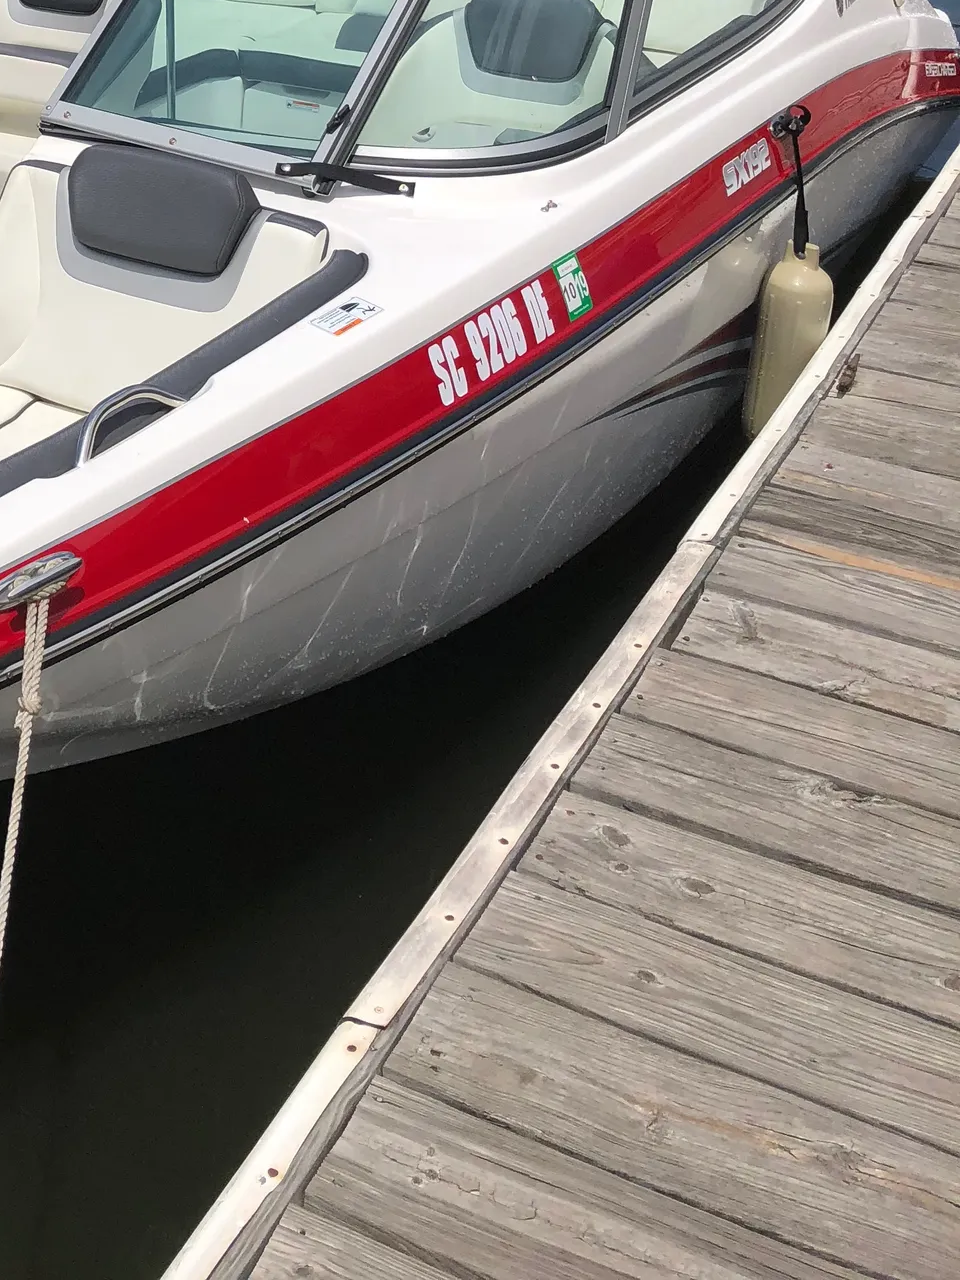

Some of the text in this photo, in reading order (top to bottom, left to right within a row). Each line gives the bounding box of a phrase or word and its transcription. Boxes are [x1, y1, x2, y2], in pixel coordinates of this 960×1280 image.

[722, 137, 771, 197] SX192
[563, 282, 577, 302] 10
[573, 270, 590, 299] 19
[427, 279, 556, 406] SC 9206 DE
